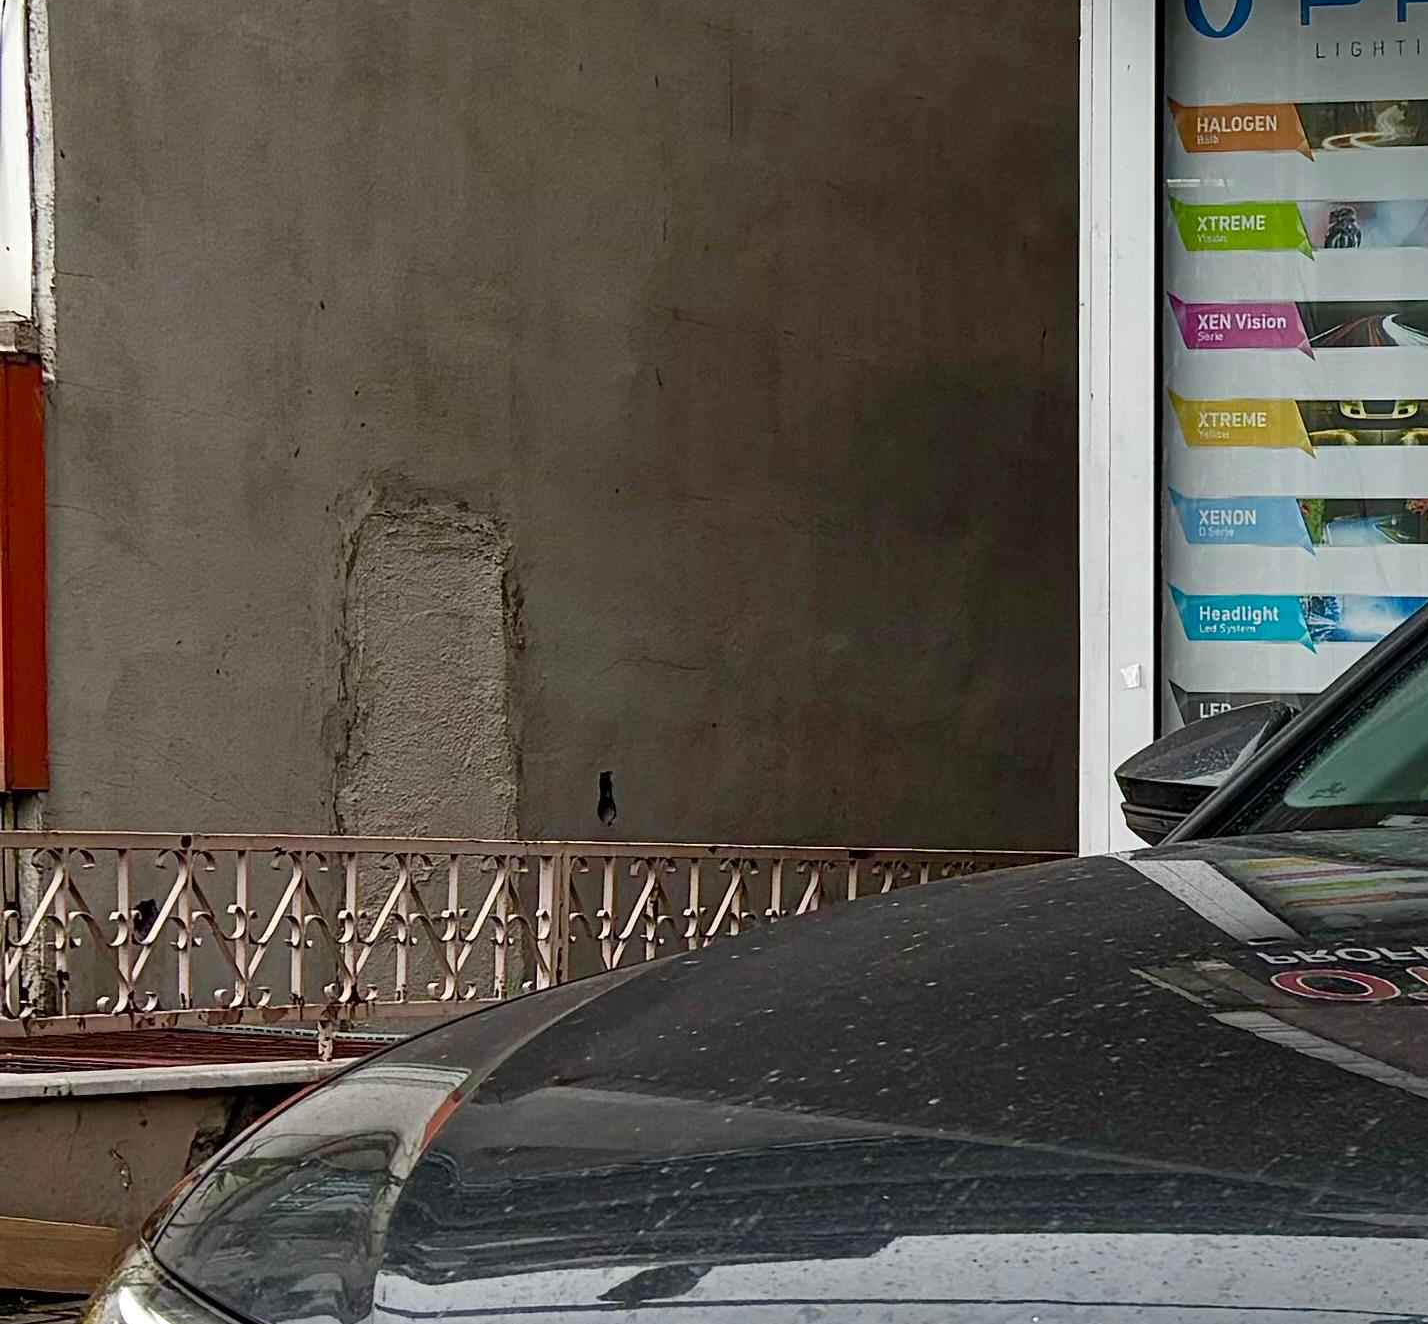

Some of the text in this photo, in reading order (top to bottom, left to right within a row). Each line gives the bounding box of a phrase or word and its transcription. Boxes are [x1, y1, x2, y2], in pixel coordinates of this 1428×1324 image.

[1197, 115, 1278, 133] HALOGEN
[1197, 214, 1267, 232] XTREME
[1198, 313, 1288, 331] XEN Vision
[1198, 411, 1268, 428] XTREME
[1199, 509, 1257, 526] XENON
[1199, 605, 1280, 625] Headlight
